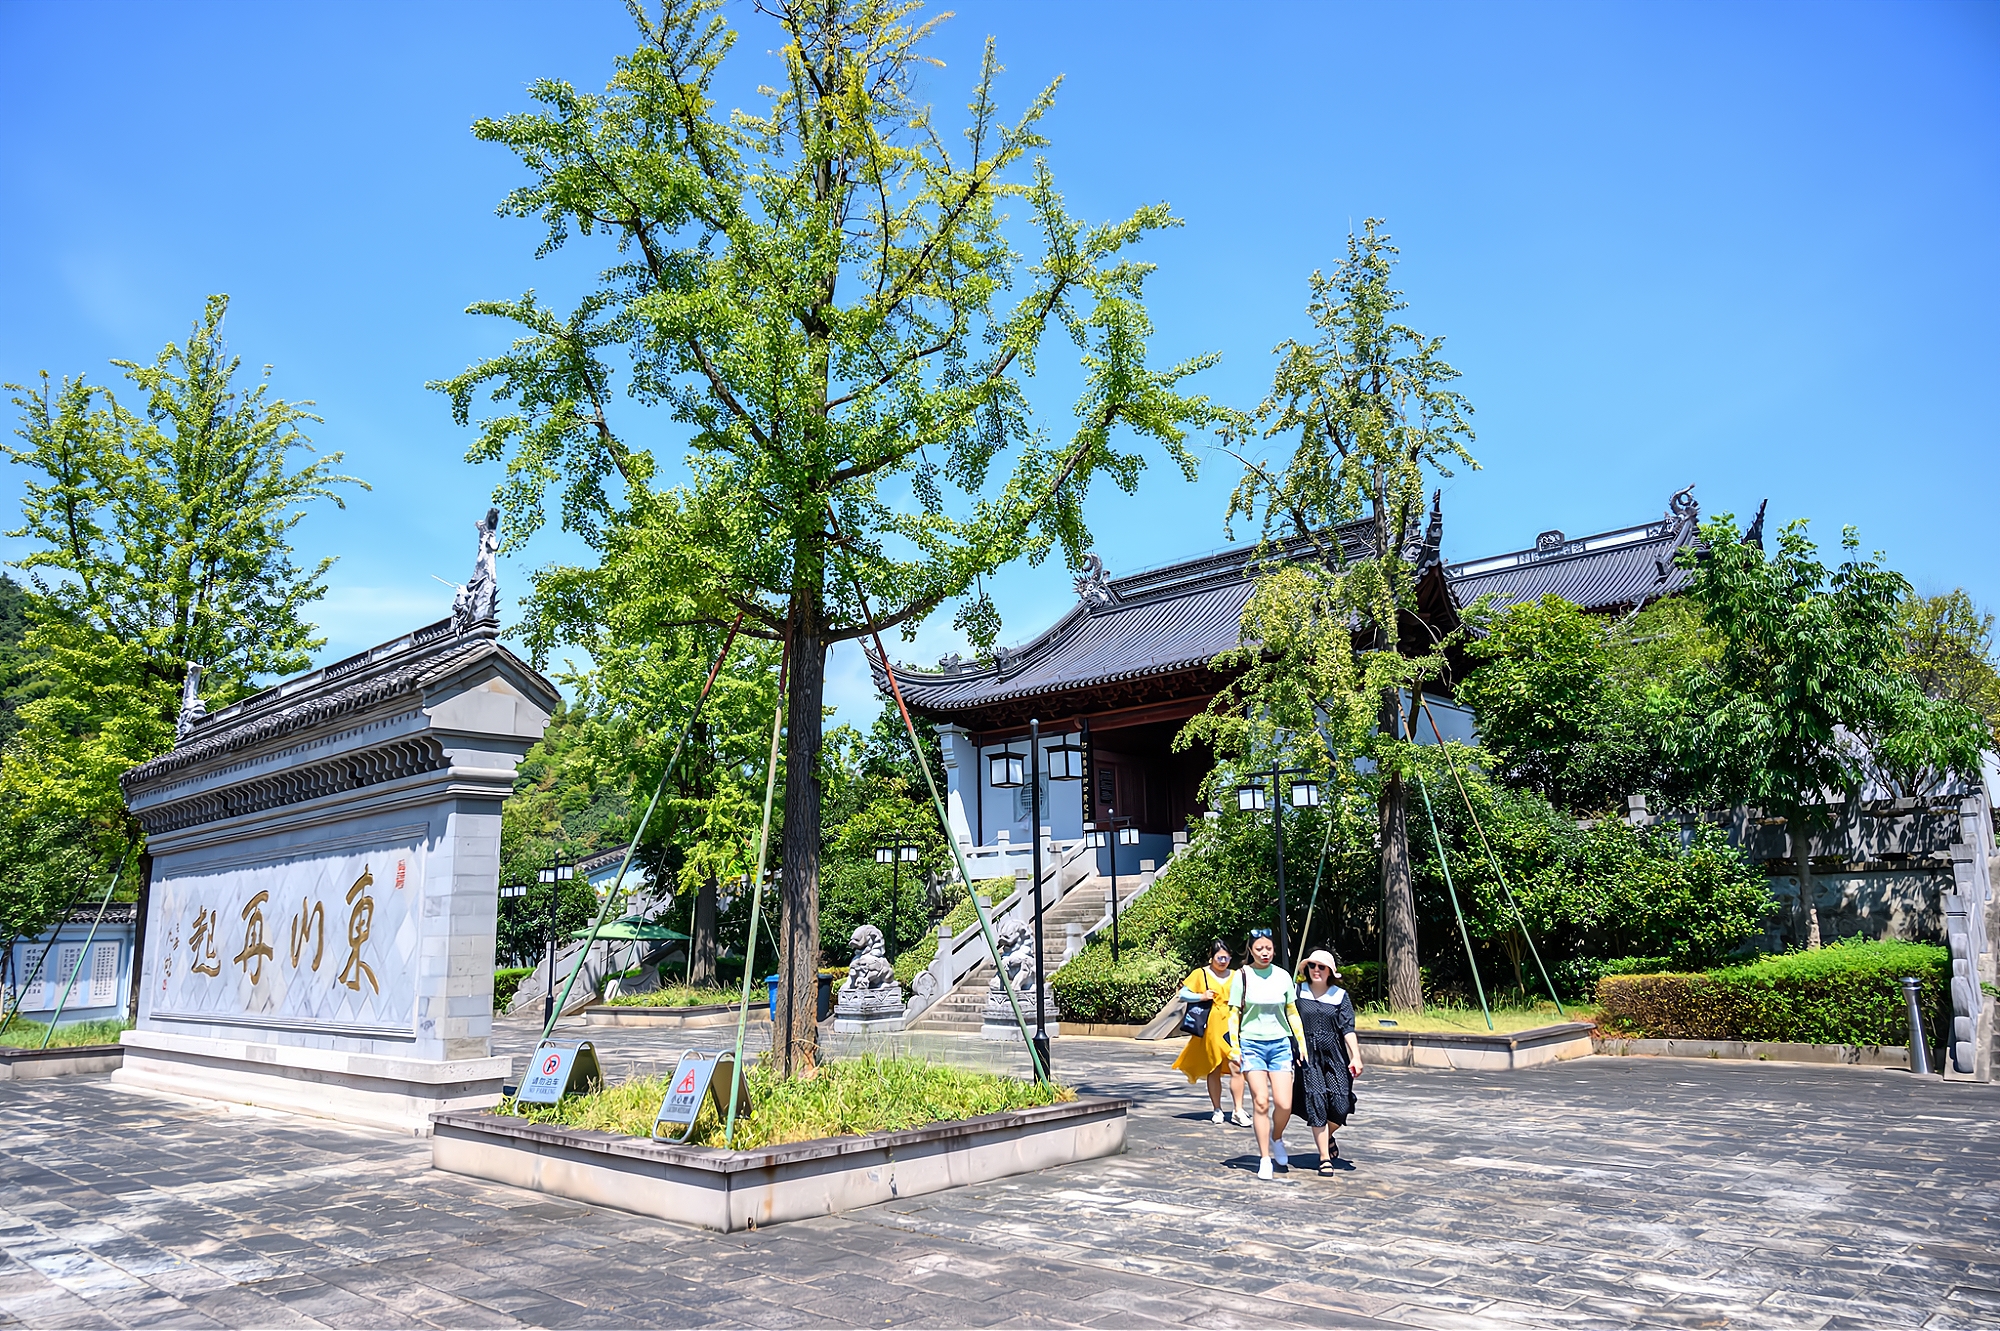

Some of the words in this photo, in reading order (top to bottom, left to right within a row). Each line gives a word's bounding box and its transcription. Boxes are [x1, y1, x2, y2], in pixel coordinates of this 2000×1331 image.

[531, 1076, 560, 1087] 请勿泊车
[536, 1088, 557, 1096] PARKING
